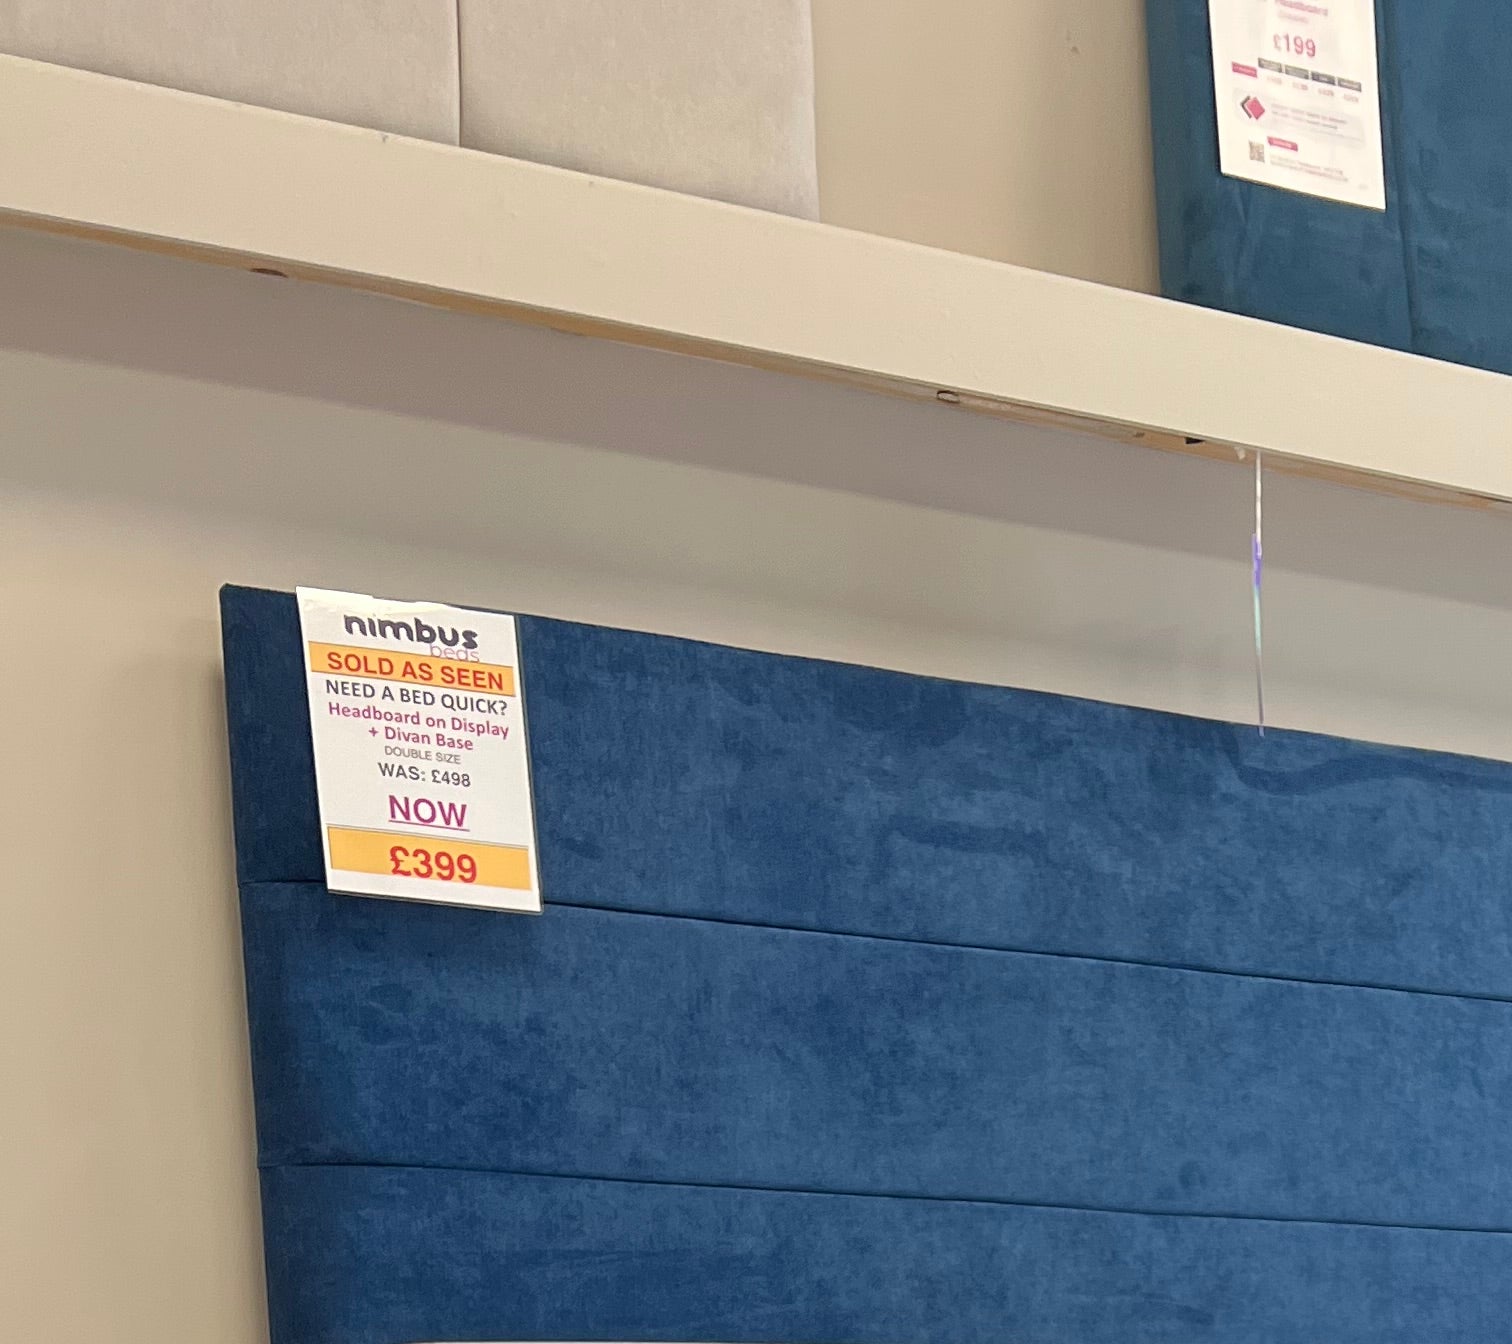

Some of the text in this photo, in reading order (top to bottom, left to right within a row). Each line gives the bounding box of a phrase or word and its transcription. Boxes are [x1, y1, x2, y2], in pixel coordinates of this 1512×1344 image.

[1273, 33, 1317, 57] £199
[343, 614, 479, 650] nimbus
[429, 643, 481, 664] beds
[327, 652, 504, 691] SOLD AS SEEN
[326, 679, 508, 716] NEED A BED QUICK?
[328, 702, 510, 741] Headboard on Display
[384, 726, 431, 745] Divan
[436, 733, 474, 750] Base
[384, 745, 462, 765] DOUBLE SIZE
[377, 762, 472, 788] WAS: £498
[388, 795, 468, 828] NOW
[389, 845, 478, 884] £399
